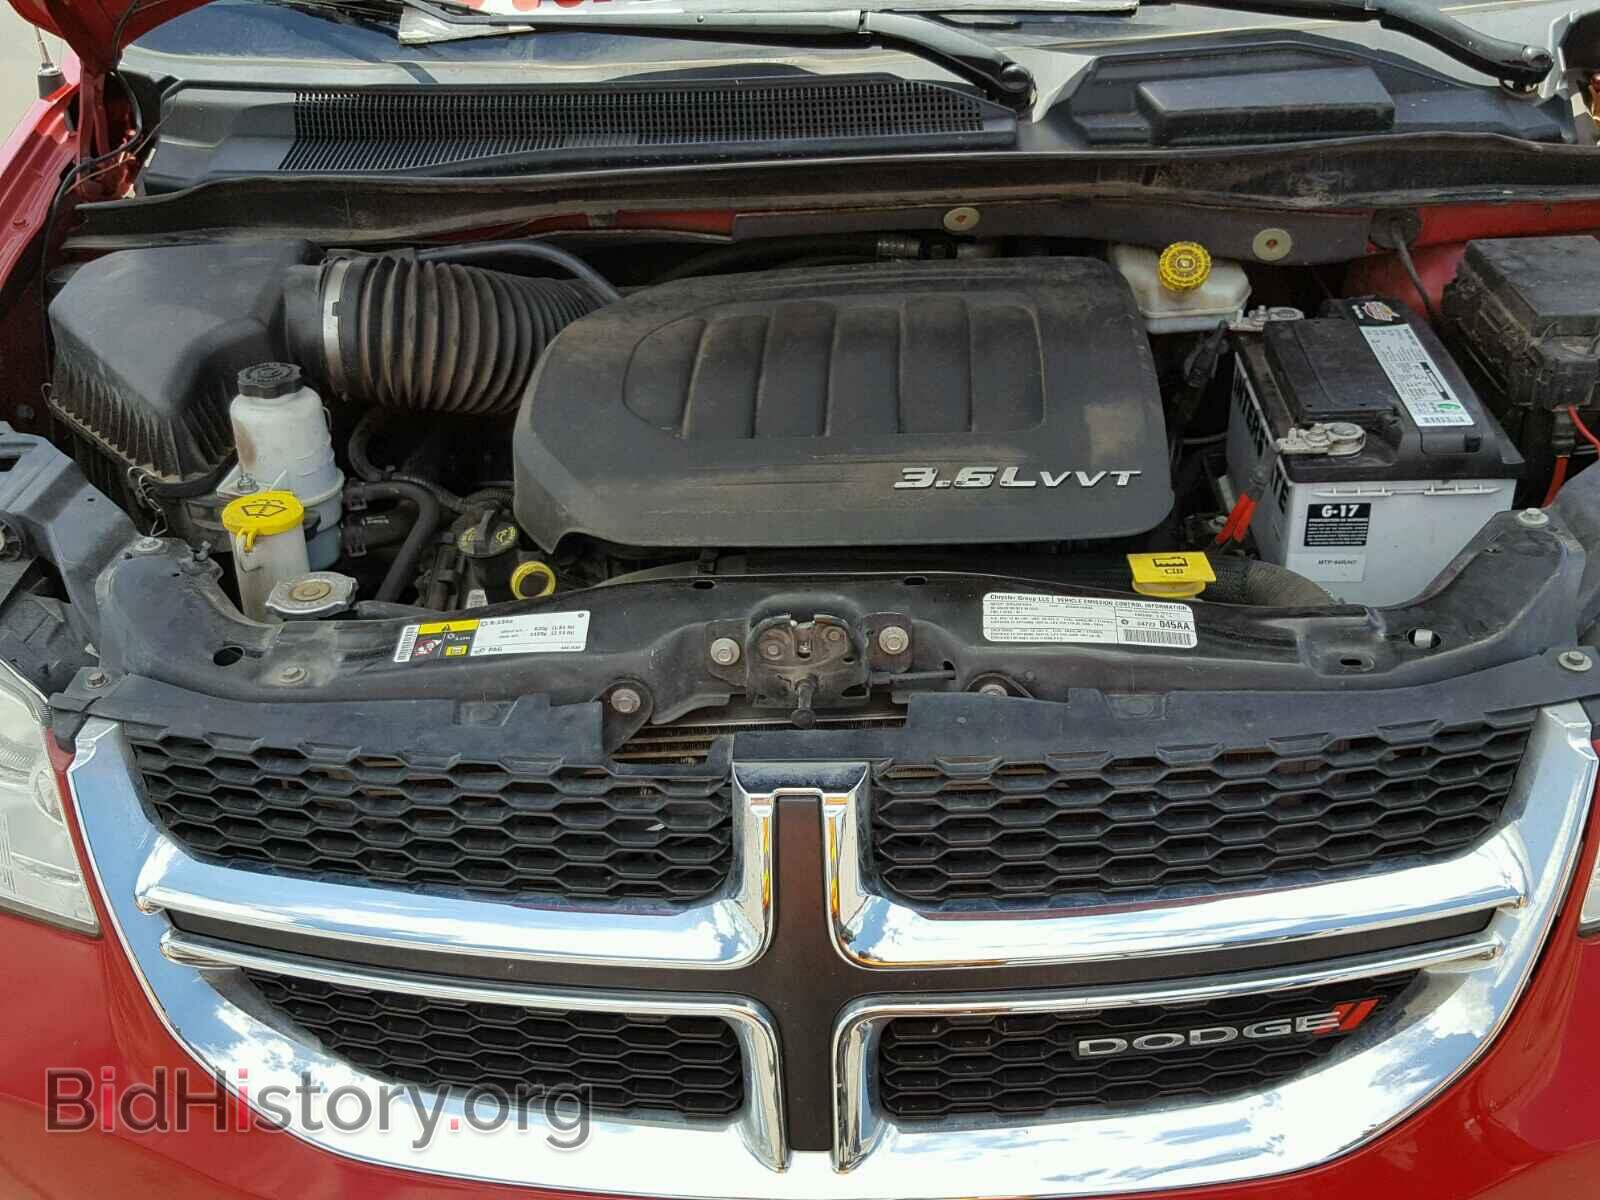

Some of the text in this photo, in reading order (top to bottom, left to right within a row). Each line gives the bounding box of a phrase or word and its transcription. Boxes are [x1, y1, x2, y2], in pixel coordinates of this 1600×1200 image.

[1321, 504, 1360, 518] G-17
[990, 593, 1016, 602] Chrysler
[1017, 594, 1035, 603] Group
[1115, 600, 1142, 608] CONTROL
[1144, 602, 1188, 611] INFORMATION
[1078, 1011, 1341, 1057] DODGE
